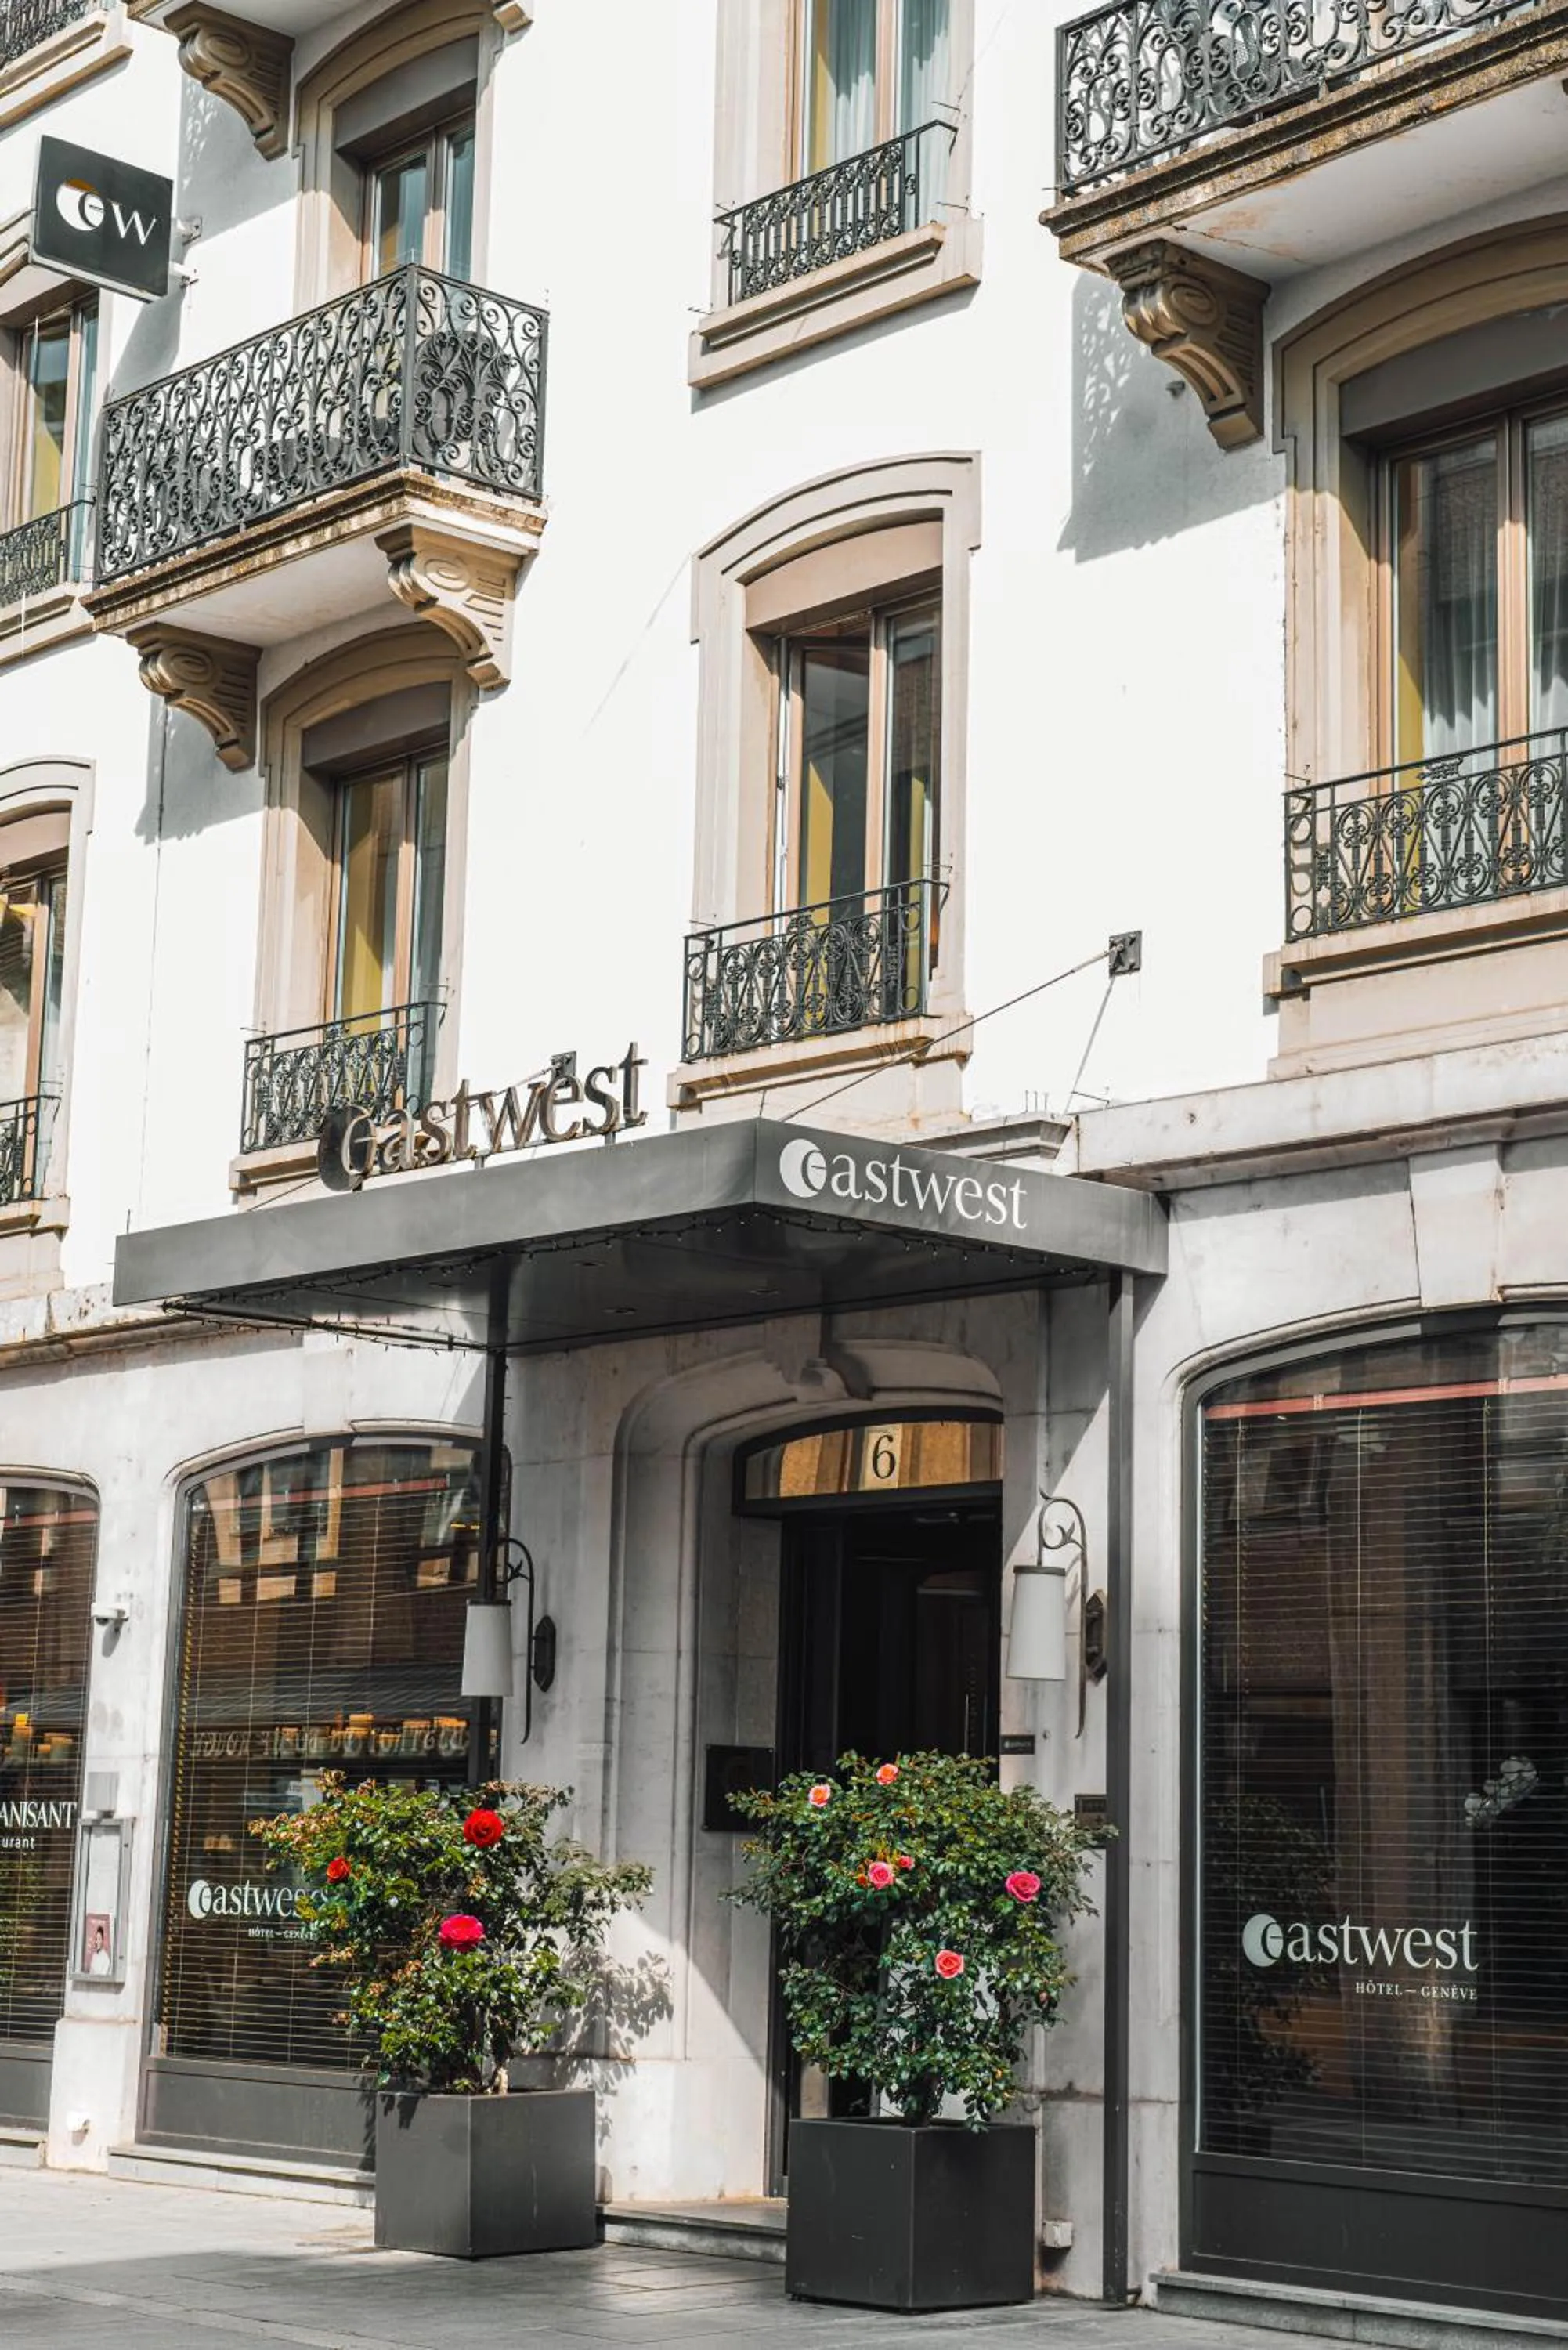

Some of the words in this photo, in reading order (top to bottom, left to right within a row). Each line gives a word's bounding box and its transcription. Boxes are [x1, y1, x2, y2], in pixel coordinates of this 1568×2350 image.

[317, 1041, 649, 1191] eastwest
[779, 1138, 1028, 1229] eastwest
[872, 1434, 897, 1480] 6
[0, 1801, 78, 1828] ANISANT
[187, 1879, 310, 1919] eastwes
[1242, 1914, 1479, 1972] eastwest
[1355, 1979, 1403, 1996] HÔTEL
